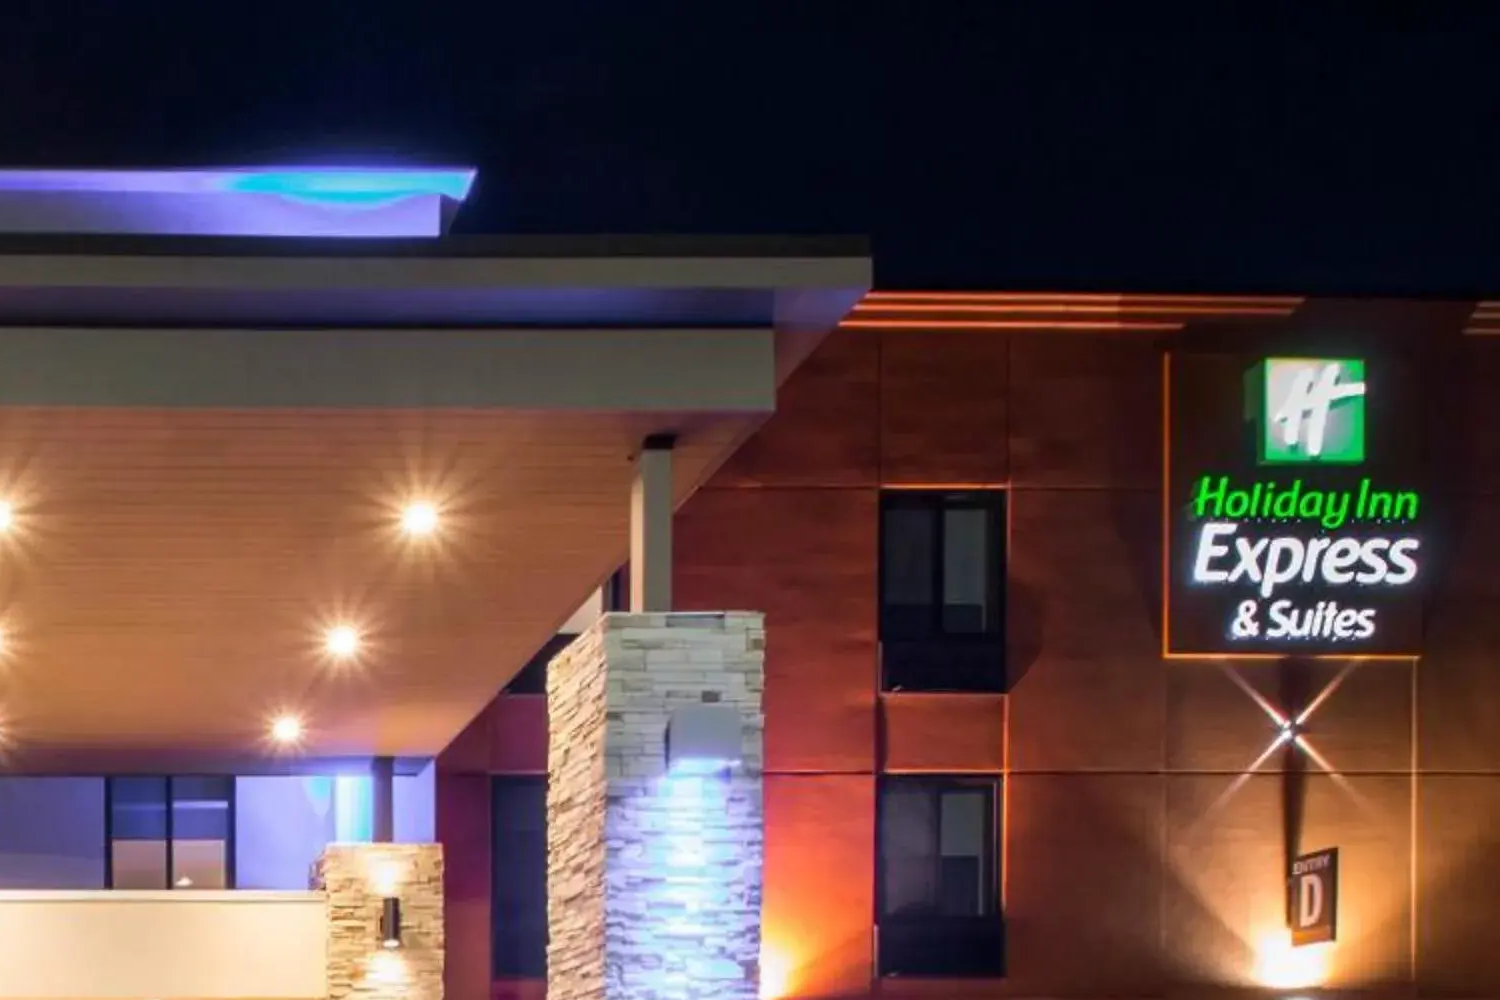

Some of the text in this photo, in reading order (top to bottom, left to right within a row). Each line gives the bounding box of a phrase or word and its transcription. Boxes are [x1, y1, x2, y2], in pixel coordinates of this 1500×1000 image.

[1194, 476, 1419, 529] Holiday Inn
[1193, 522, 1420, 598] Express
[1231, 600, 1377, 638] & Suites
[1300, 873, 1323, 928] D
